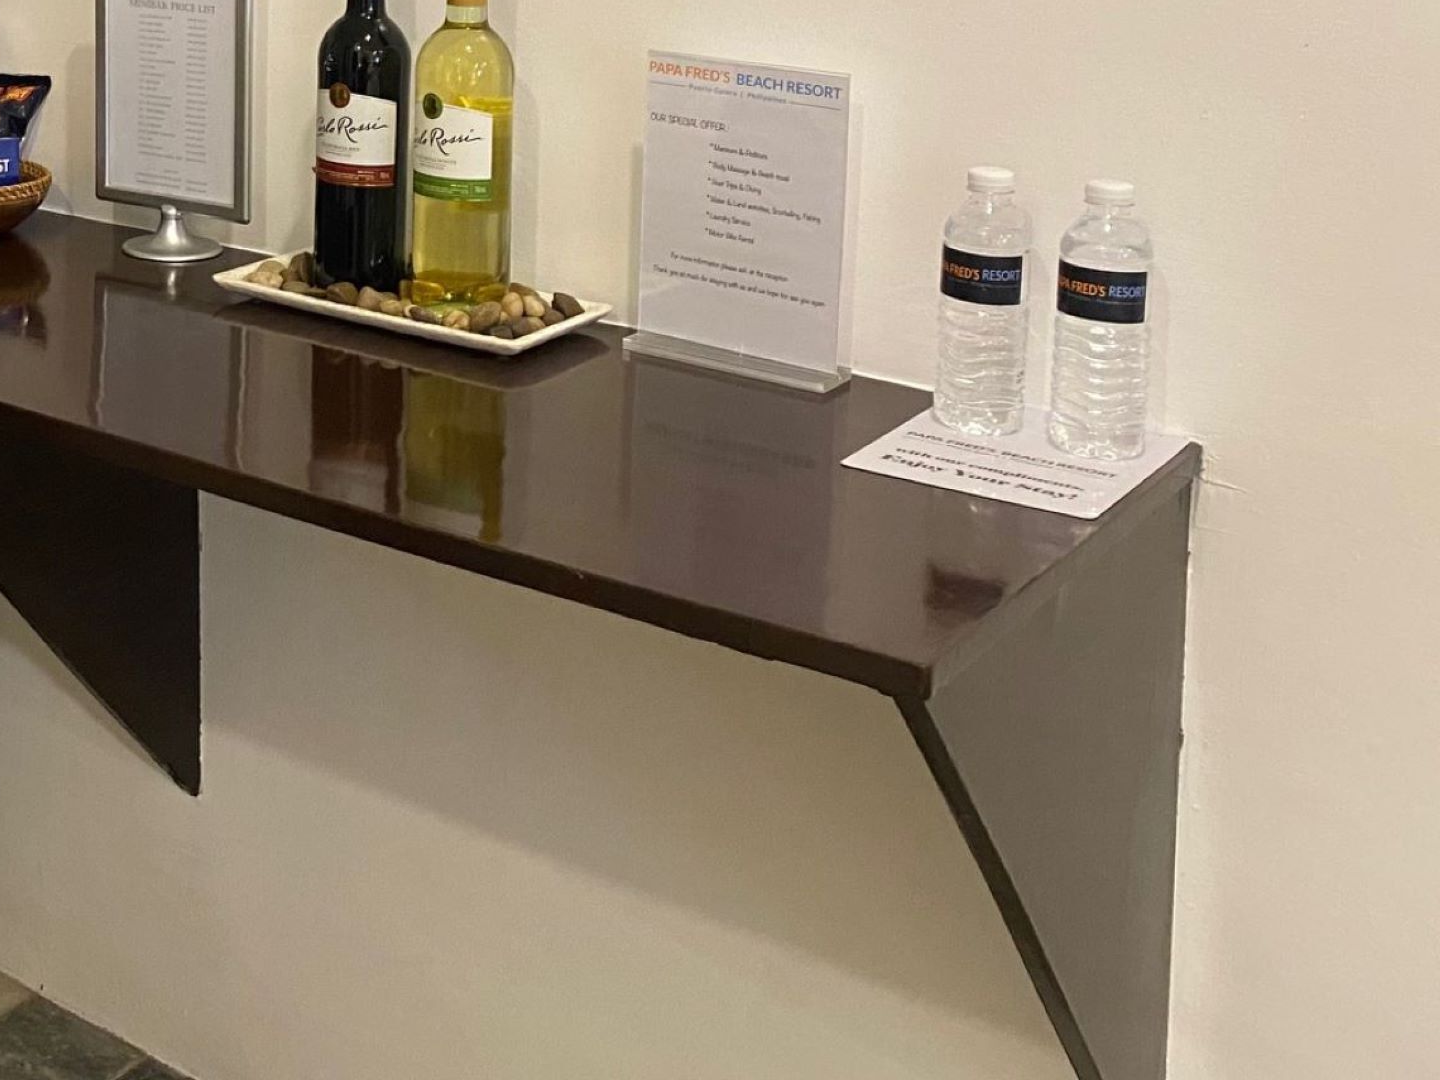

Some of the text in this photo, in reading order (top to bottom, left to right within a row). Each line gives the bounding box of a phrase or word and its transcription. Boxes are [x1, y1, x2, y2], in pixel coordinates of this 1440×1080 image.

[171, 1, 195, 13] PRICE
[198, 5, 216, 15] LIST
[650, 60, 843, 100] PAPA FRED'S BEACH RESORT
[337, 116, 389, 143] Rossi
[650, 112, 667, 122] OUR
[669, 114, 698, 128] SPECIAL
[430, 127, 481, 156] Rossi
[950, 262, 980, 281] FRED'S
[982, 269, 1021, 282] RESORT
[1071, 280, 1106, 297] FRED'S
[1108, 285, 1146, 298] RESORT
[881, 454, 944, 473] Enjoy
[1001, 450, 1054, 466] BEACH
[1055, 462, 1118, 479] RESORT
